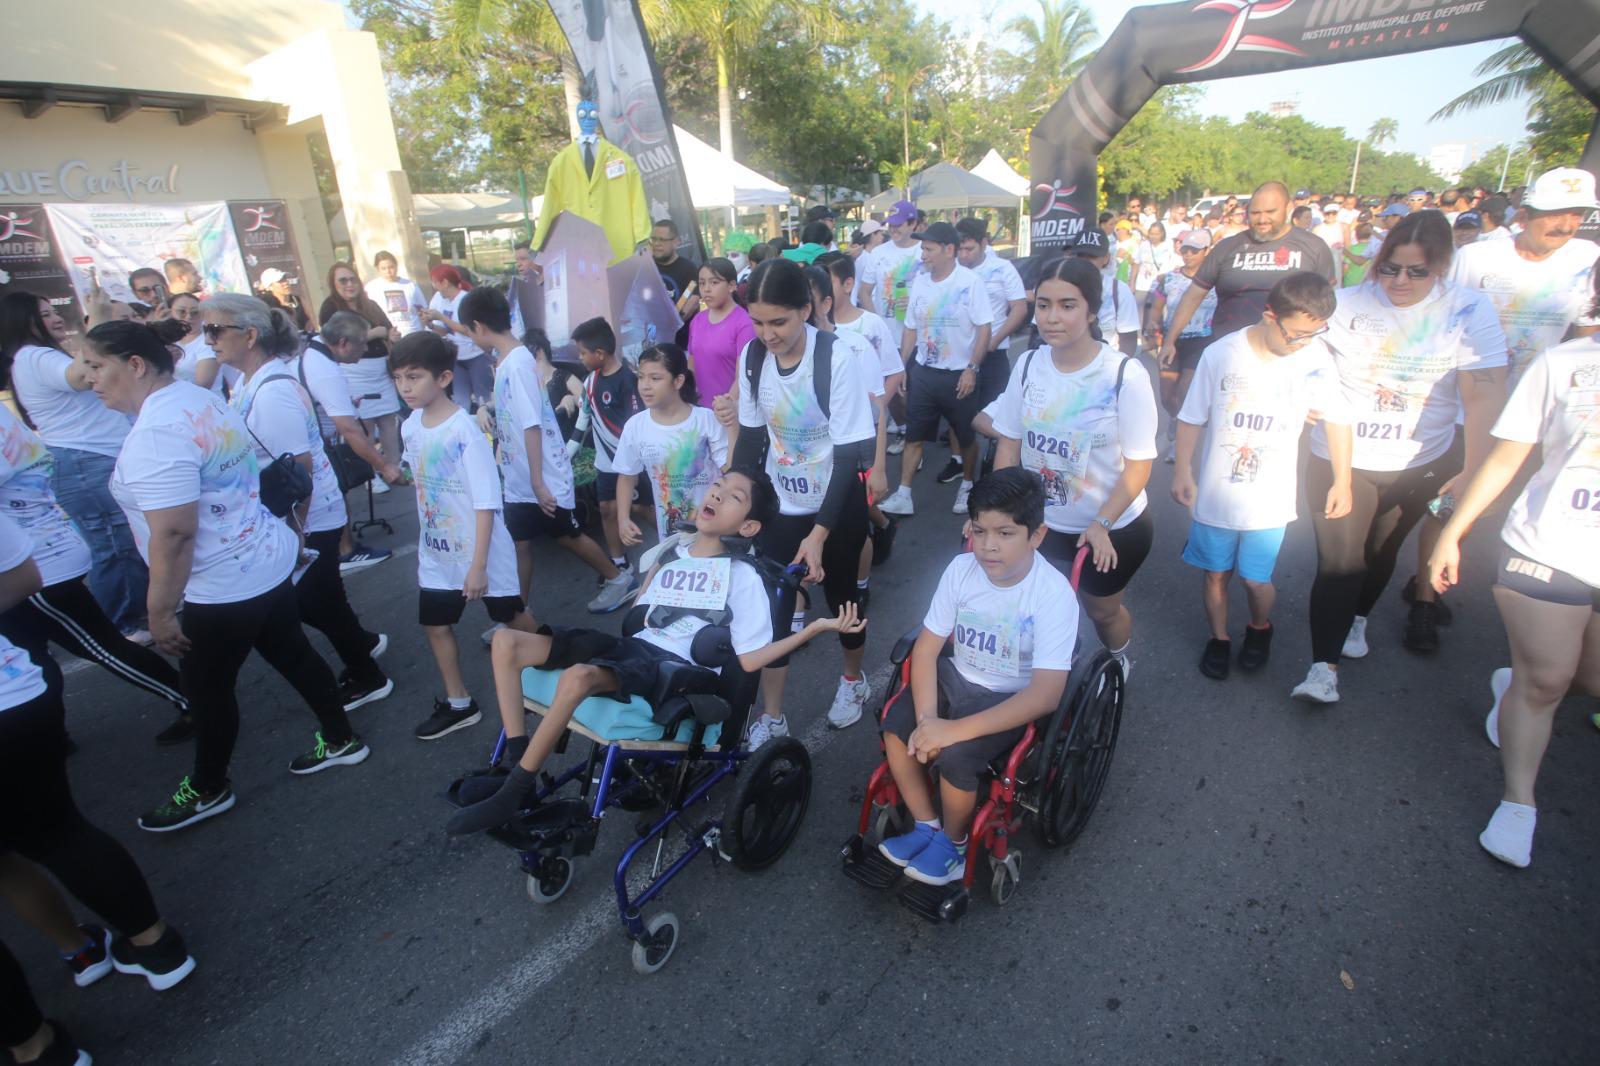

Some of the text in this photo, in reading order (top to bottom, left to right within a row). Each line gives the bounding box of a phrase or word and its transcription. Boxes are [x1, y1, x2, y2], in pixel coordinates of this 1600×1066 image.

[1301, 0, 1487, 41] INSTITUTO MUNICIPAL DEL DEPORTE
[1327, 22, 1449, 49] MAZATLÁN
[58, 159, 179, 201] Central
[1233, 412, 1274, 431] 0107
[1357, 422, 1402, 440] 0221
[1027, 431, 1070, 459] 0226
[660, 569, 709, 593] 0212
[957, 624, 997, 656] 0214
